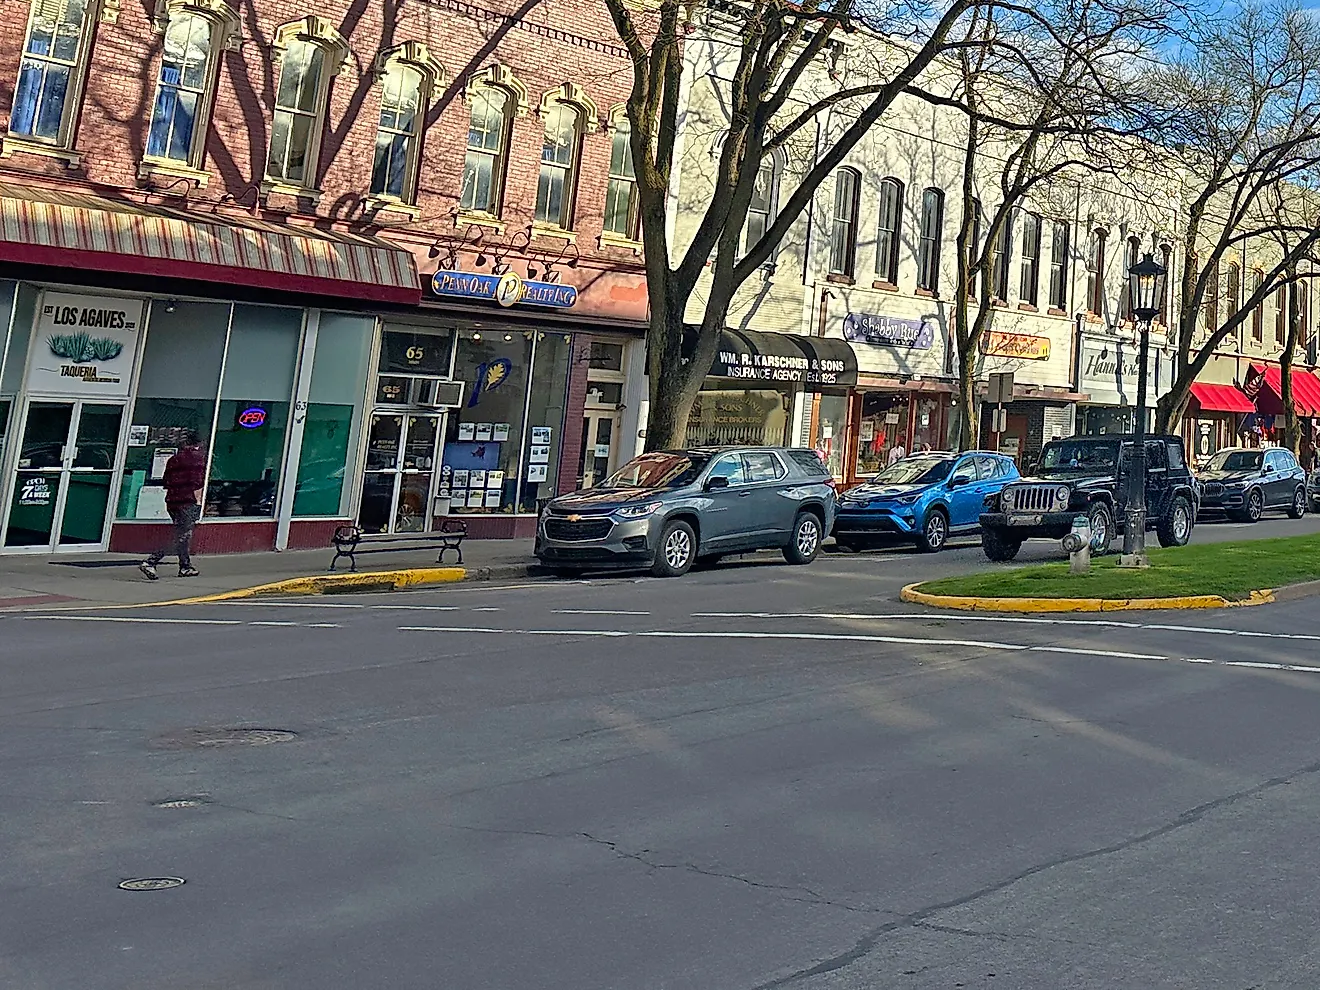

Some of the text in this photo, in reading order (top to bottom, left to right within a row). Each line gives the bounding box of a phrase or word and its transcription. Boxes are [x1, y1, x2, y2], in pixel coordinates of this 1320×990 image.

[441, 275, 492, 295] PENN OAK
[54, 307, 78, 326] LOS
[79, 309, 126, 329] AGAVES
[861, 318, 898, 336] Shabby
[405, 346, 424, 360] 65
[720, 351, 844, 372] WM. R. KARSCHNER & SONS
[61, 366, 97, 378] TAQUERIA
[728, 366, 771, 380] INSURANCE
[772, 370, 802, 382] AGENCY
[821, 373, 836, 384] 1925
[295, 401, 307, 411] 63
[21, 485, 34, 499] 7
